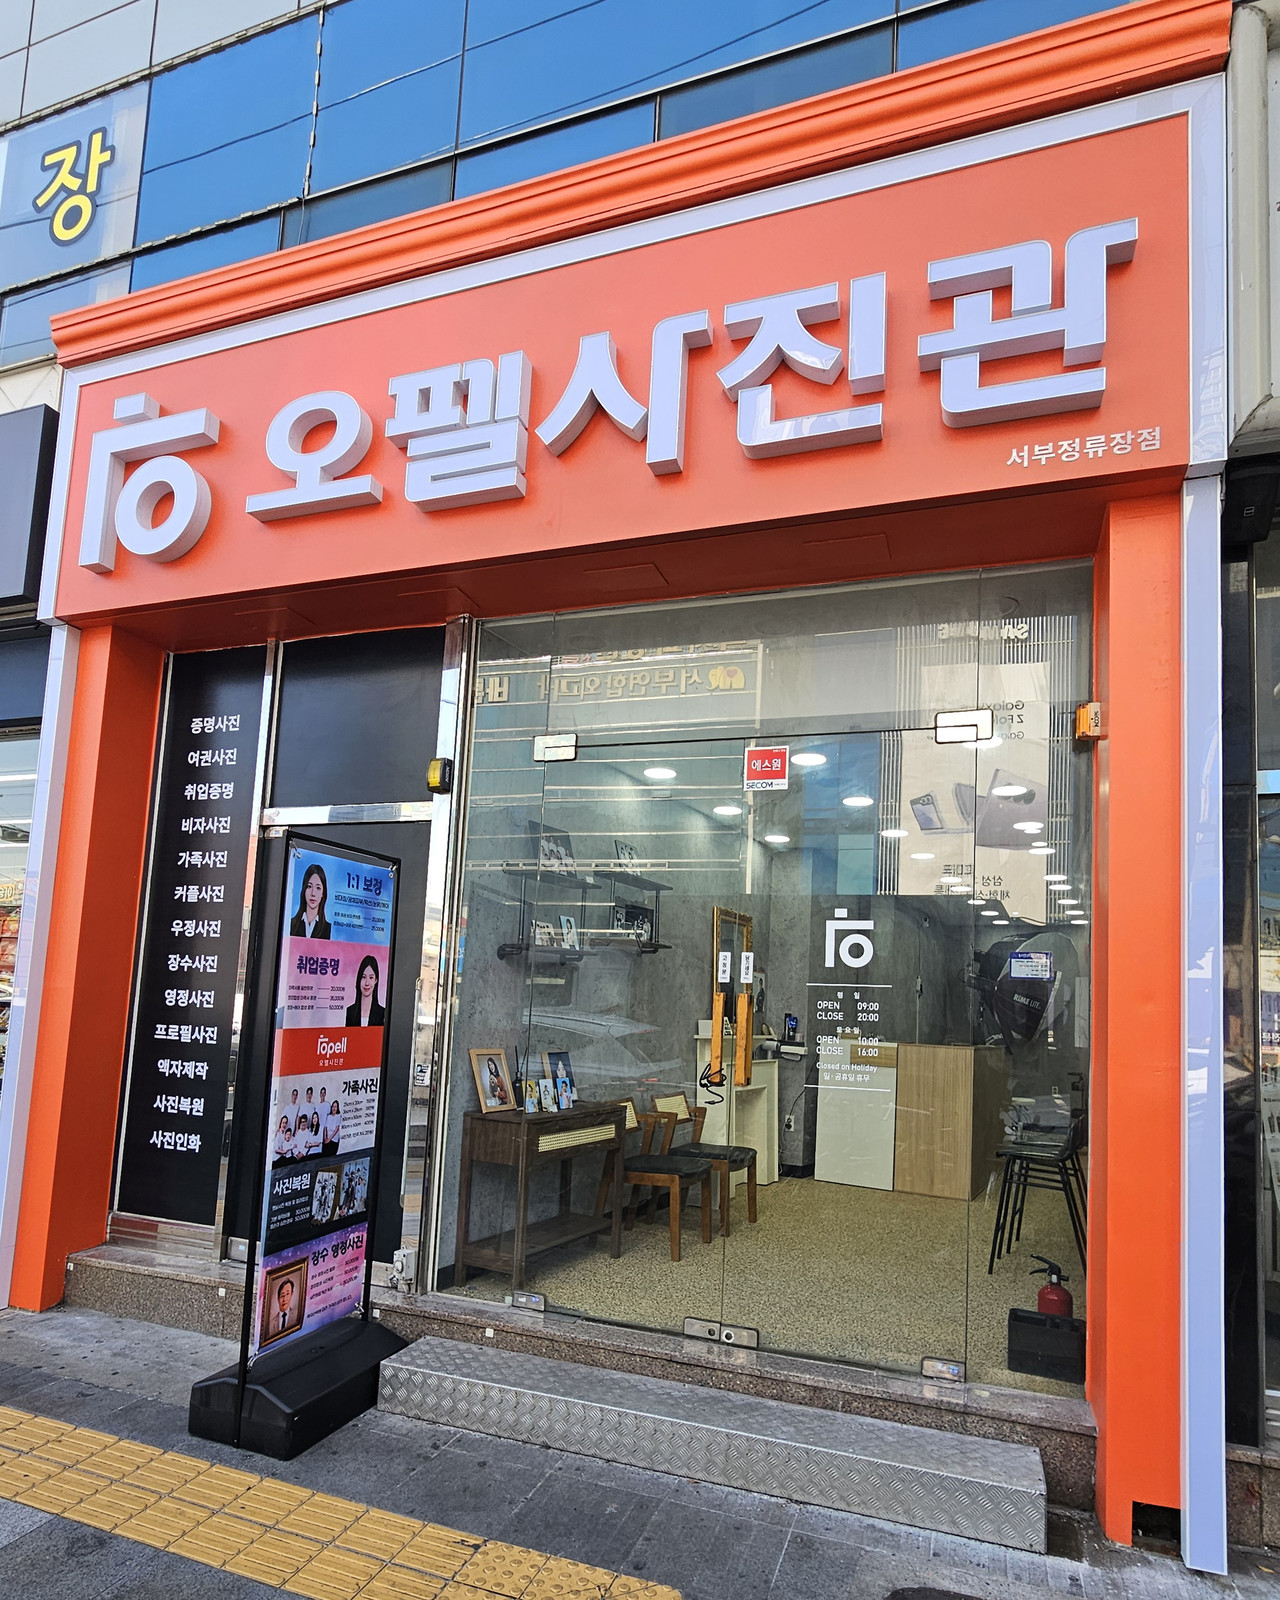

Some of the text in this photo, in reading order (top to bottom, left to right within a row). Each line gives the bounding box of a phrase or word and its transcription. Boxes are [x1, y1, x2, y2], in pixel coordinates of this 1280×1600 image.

[34, 127, 115, 246] 장
[245, 216, 1139, 522] 오펠사진관
[1006, 426, 1161, 468] 서부정류장점
[190, 714, 241, 735] 증명사진
[187, 748, 237, 767] 여권사진
[751, 758, 782, 772] 에스원
[184, 782, 234, 801] 취업증명
[746, 781, 774, 790] SECOM
[180, 816, 231, 835] 비자사진
[177, 850, 228, 869] 가족사진
[173, 884, 225, 903] 커플사진
[346, 872, 383, 896] 1:1 보정
[170, 919, 222, 938] 우정사진
[167, 953, 218, 973] 장수사진
[296, 955, 340, 976] 취업증명
[164, 989, 215, 1008] 영정사진
[817, 1001, 879, 1011] OPEN 09:00
[816, 1011, 879, 1022] CLOSE 20:00
[153, 1024, 218, 1045] 프로필사진
[816, 1035, 879, 1046] OPEN 10:00
[816, 1046, 879, 1057] CLOSE 16:00
[157, 1058, 208, 1081] 액자제작
[816, 1062, 840, 1070] Closed
[851, 1063, 878, 1073] Holiday
[342, 1078, 378, 1096] 가족사진
[153, 1094, 205, 1116] 사진복원
[149, 1130, 202, 1153] 사진인화
[273, 1172, 311, 1196] 사진복원
[311, 1234, 364, 1266] 장수 영정사진
